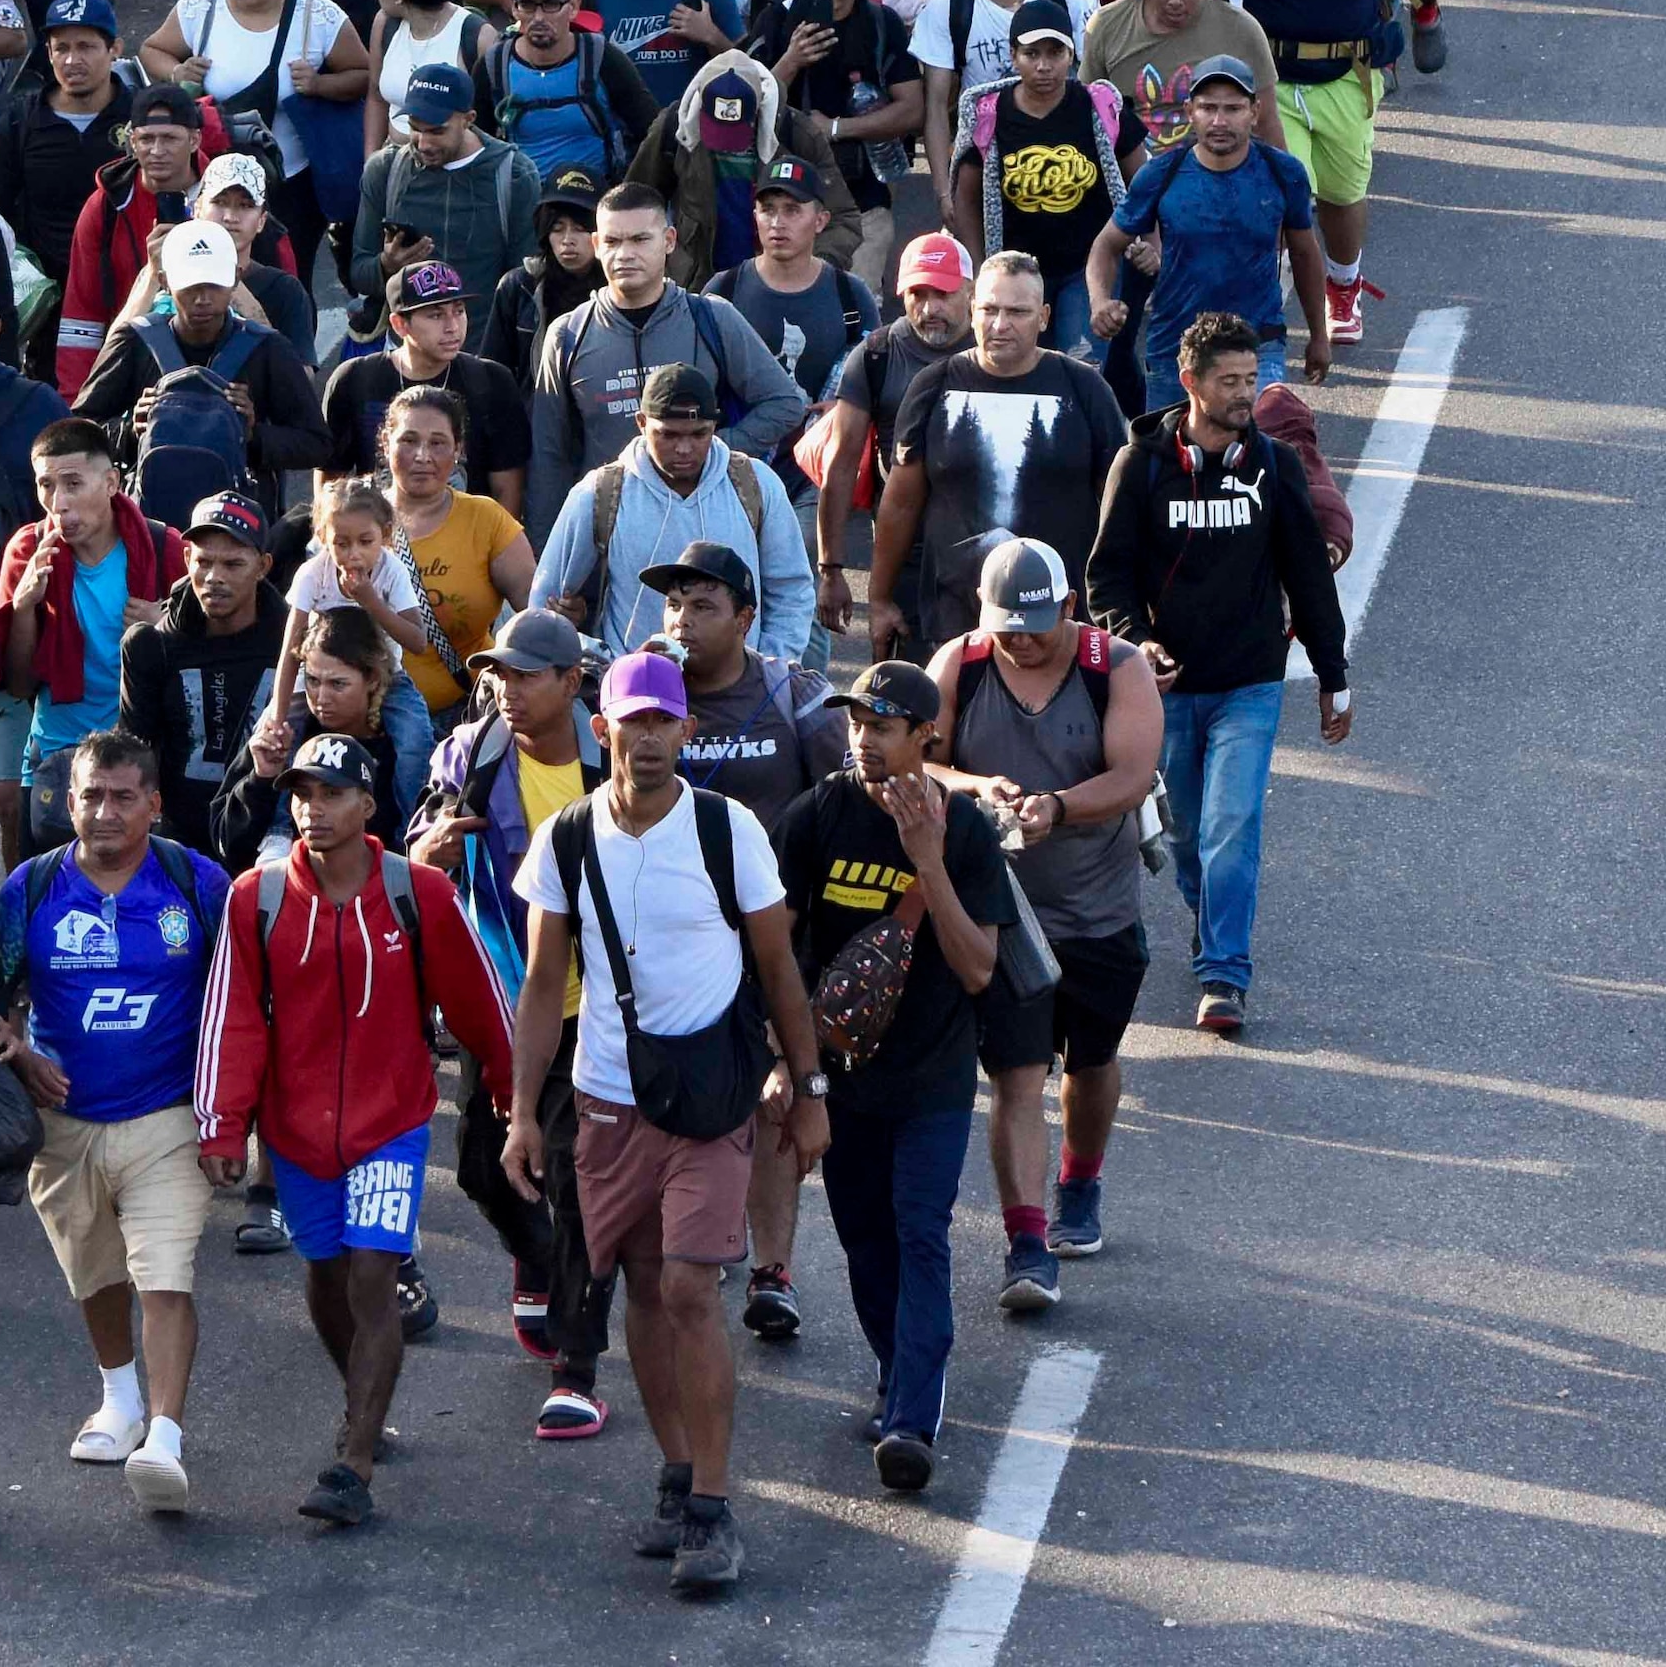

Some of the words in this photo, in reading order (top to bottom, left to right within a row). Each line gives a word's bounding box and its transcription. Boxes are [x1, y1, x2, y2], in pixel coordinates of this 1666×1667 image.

[615, 15, 665, 43] NIKE
[635, 50, 658, 61] JUST
[660, 49, 677, 60] DO
[201, 512, 248, 530] LFIGER
[1168, 497, 1252, 529] PUMA
[213, 671, 229, 730] Angeles
[212, 734, 223, 751] Los
[312, 737, 348, 769] NY
[679, 738, 776, 760] HAWKS
[81, 988, 159, 1032] P3
